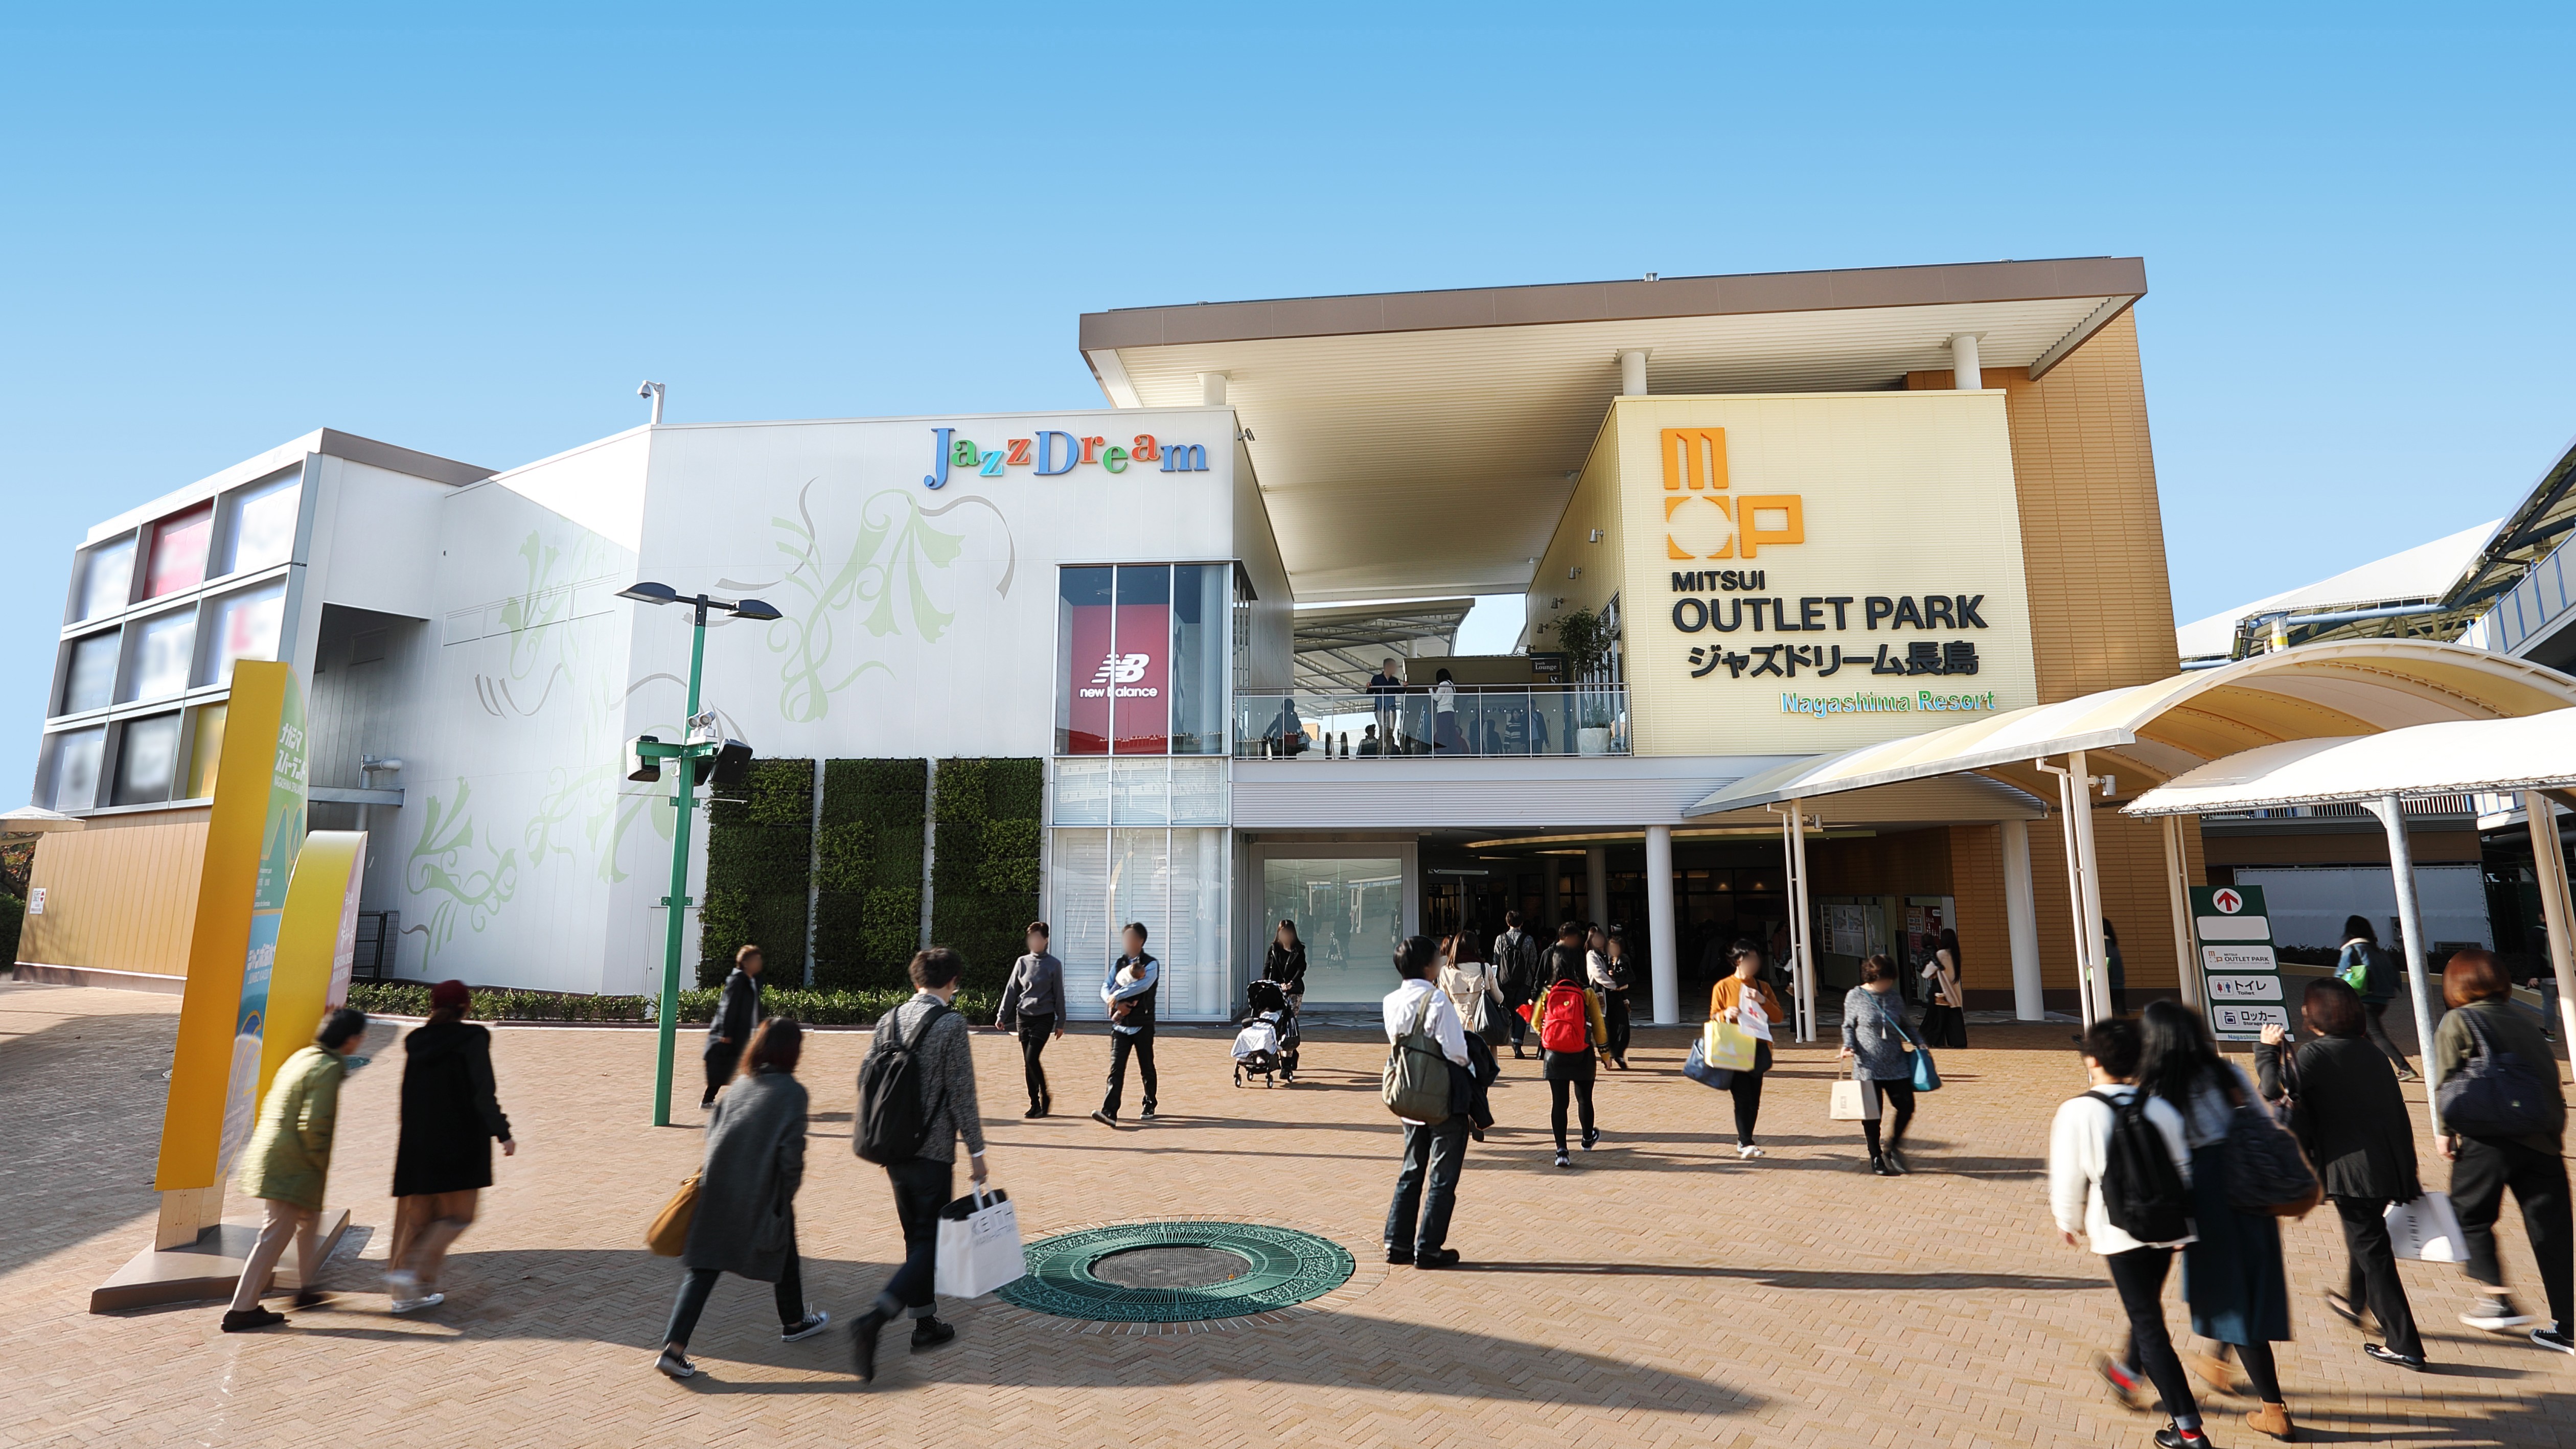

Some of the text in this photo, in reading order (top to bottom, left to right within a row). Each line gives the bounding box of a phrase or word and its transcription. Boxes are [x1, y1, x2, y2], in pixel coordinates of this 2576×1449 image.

[1672, 570, 1766, 592] MITSUI
[1672, 594, 1989, 633] OUTLET PARK
[1688, 640, 1980, 679] ジャズドリーム長島
[1079, 688, 1105, 698] new
[1781, 690, 1996, 718] Nagashima Resort
[280, 722, 303, 752] ナガシマ
[2234, 980, 2267, 991] トイレ
[2241, 1010, 2278, 1022] ロッカー
[971, 1206, 1015, 1235] KEITH
